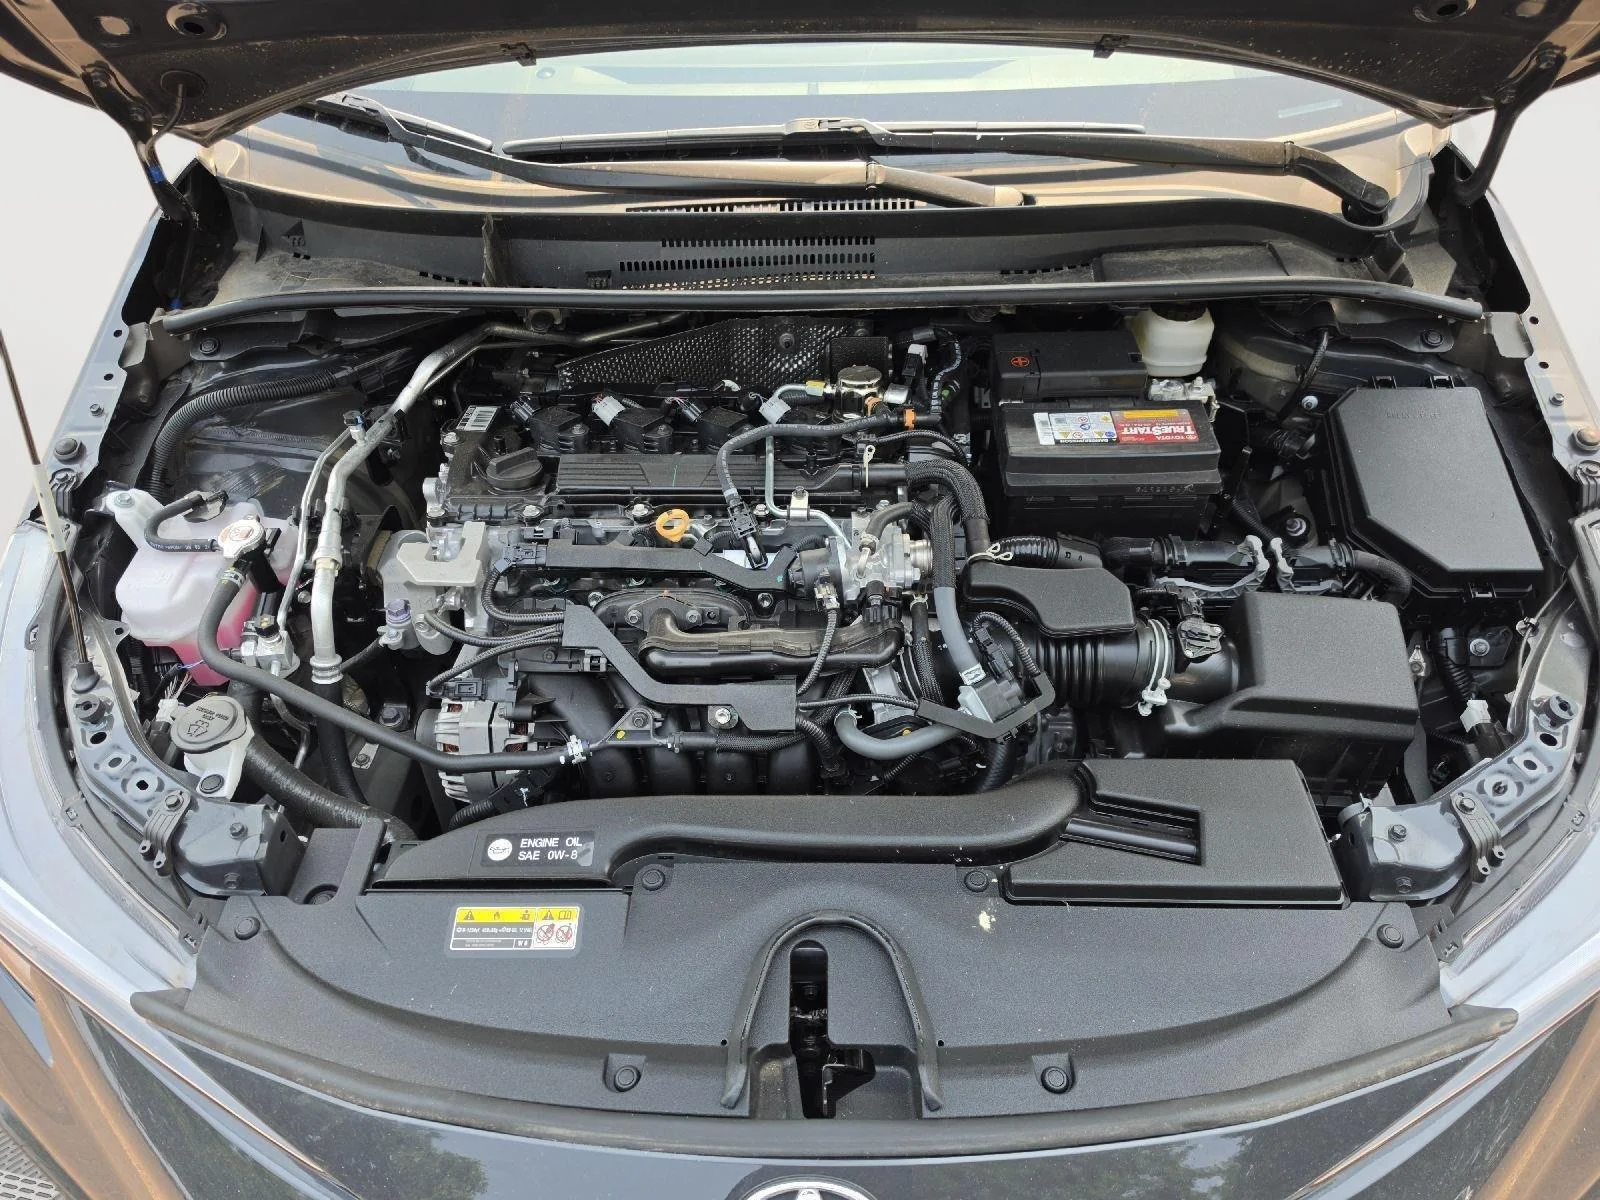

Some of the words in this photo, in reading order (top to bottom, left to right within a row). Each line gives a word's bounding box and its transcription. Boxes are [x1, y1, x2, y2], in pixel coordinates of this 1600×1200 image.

[520, 837, 560, 849] ENGINE
[565, 836, 583, 848] OIL
[517, 849, 541, 861] SAE
[547, 849, 578, 860] 0W-8
